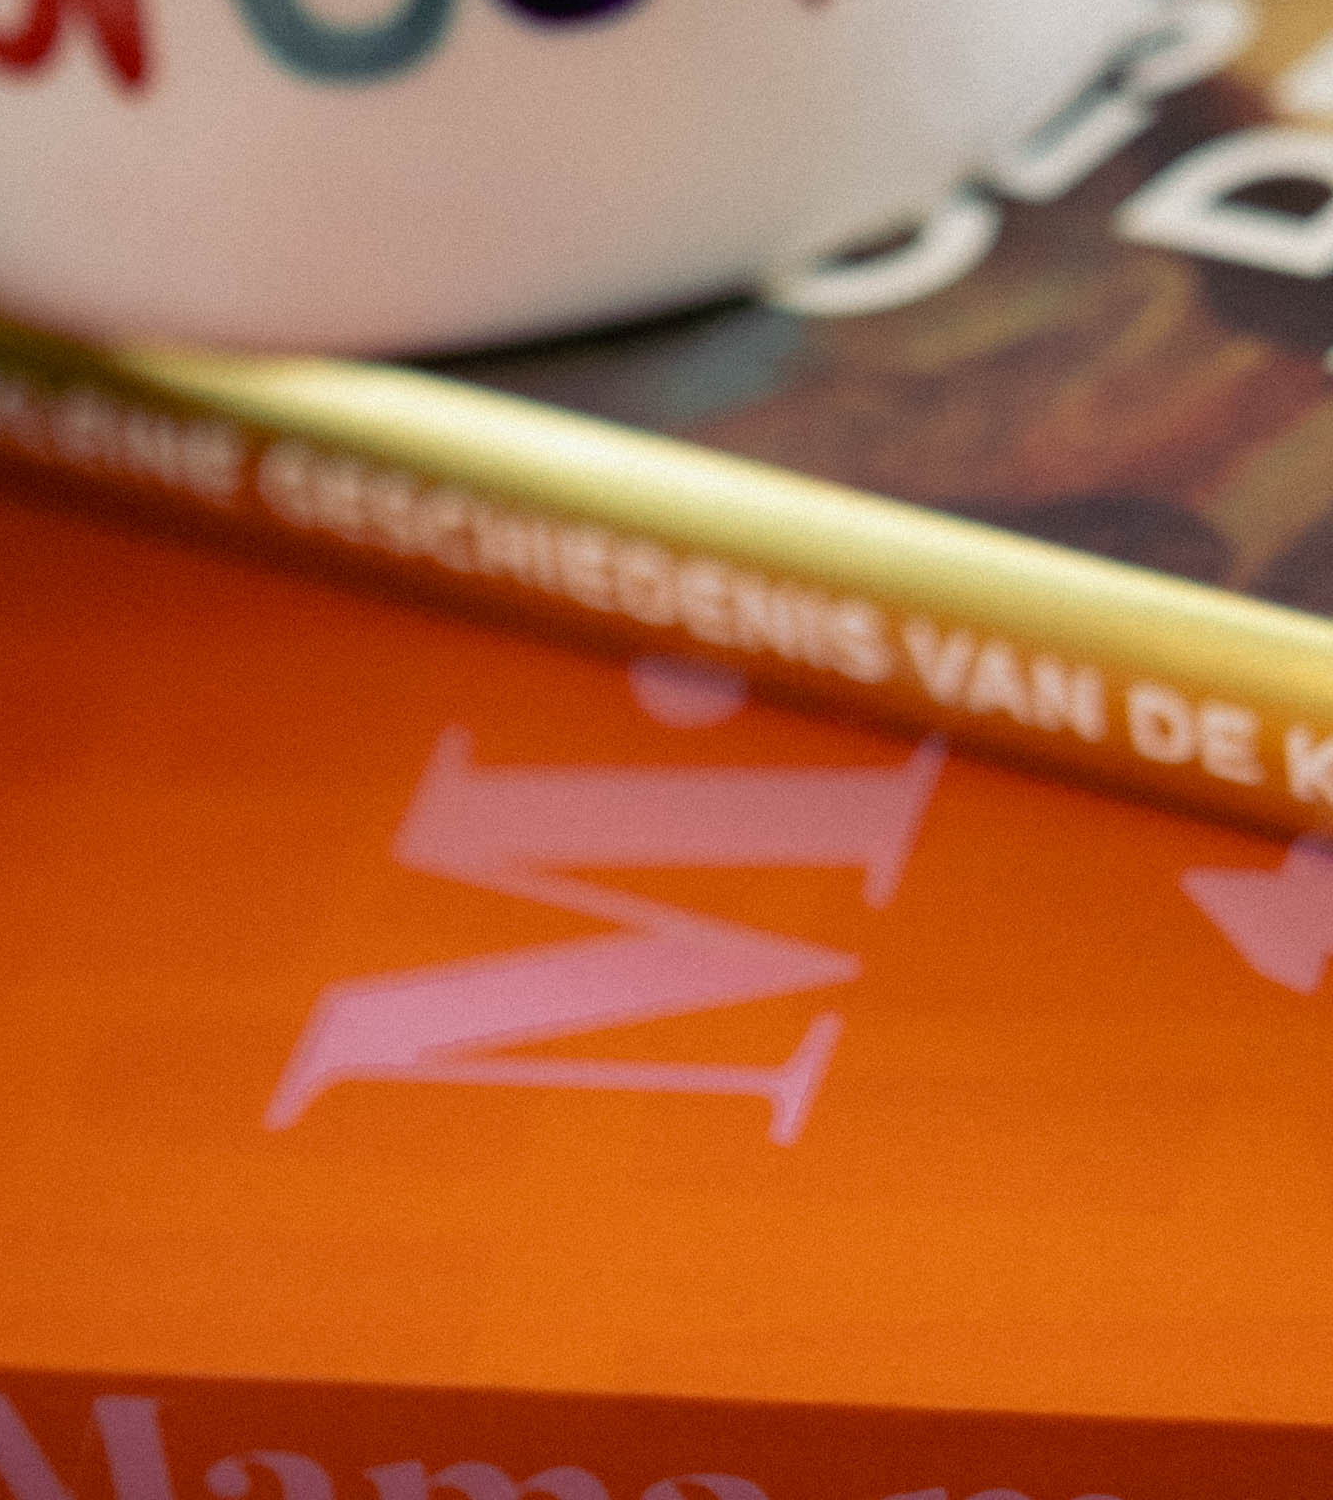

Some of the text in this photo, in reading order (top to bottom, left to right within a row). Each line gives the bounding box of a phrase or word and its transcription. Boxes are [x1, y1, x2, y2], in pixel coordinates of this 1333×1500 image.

[257, 436, 891, 684] GESCHIEDENIS
[900, 614, 1110, 744] VAN
[1126, 680, 1267, 787] DE
